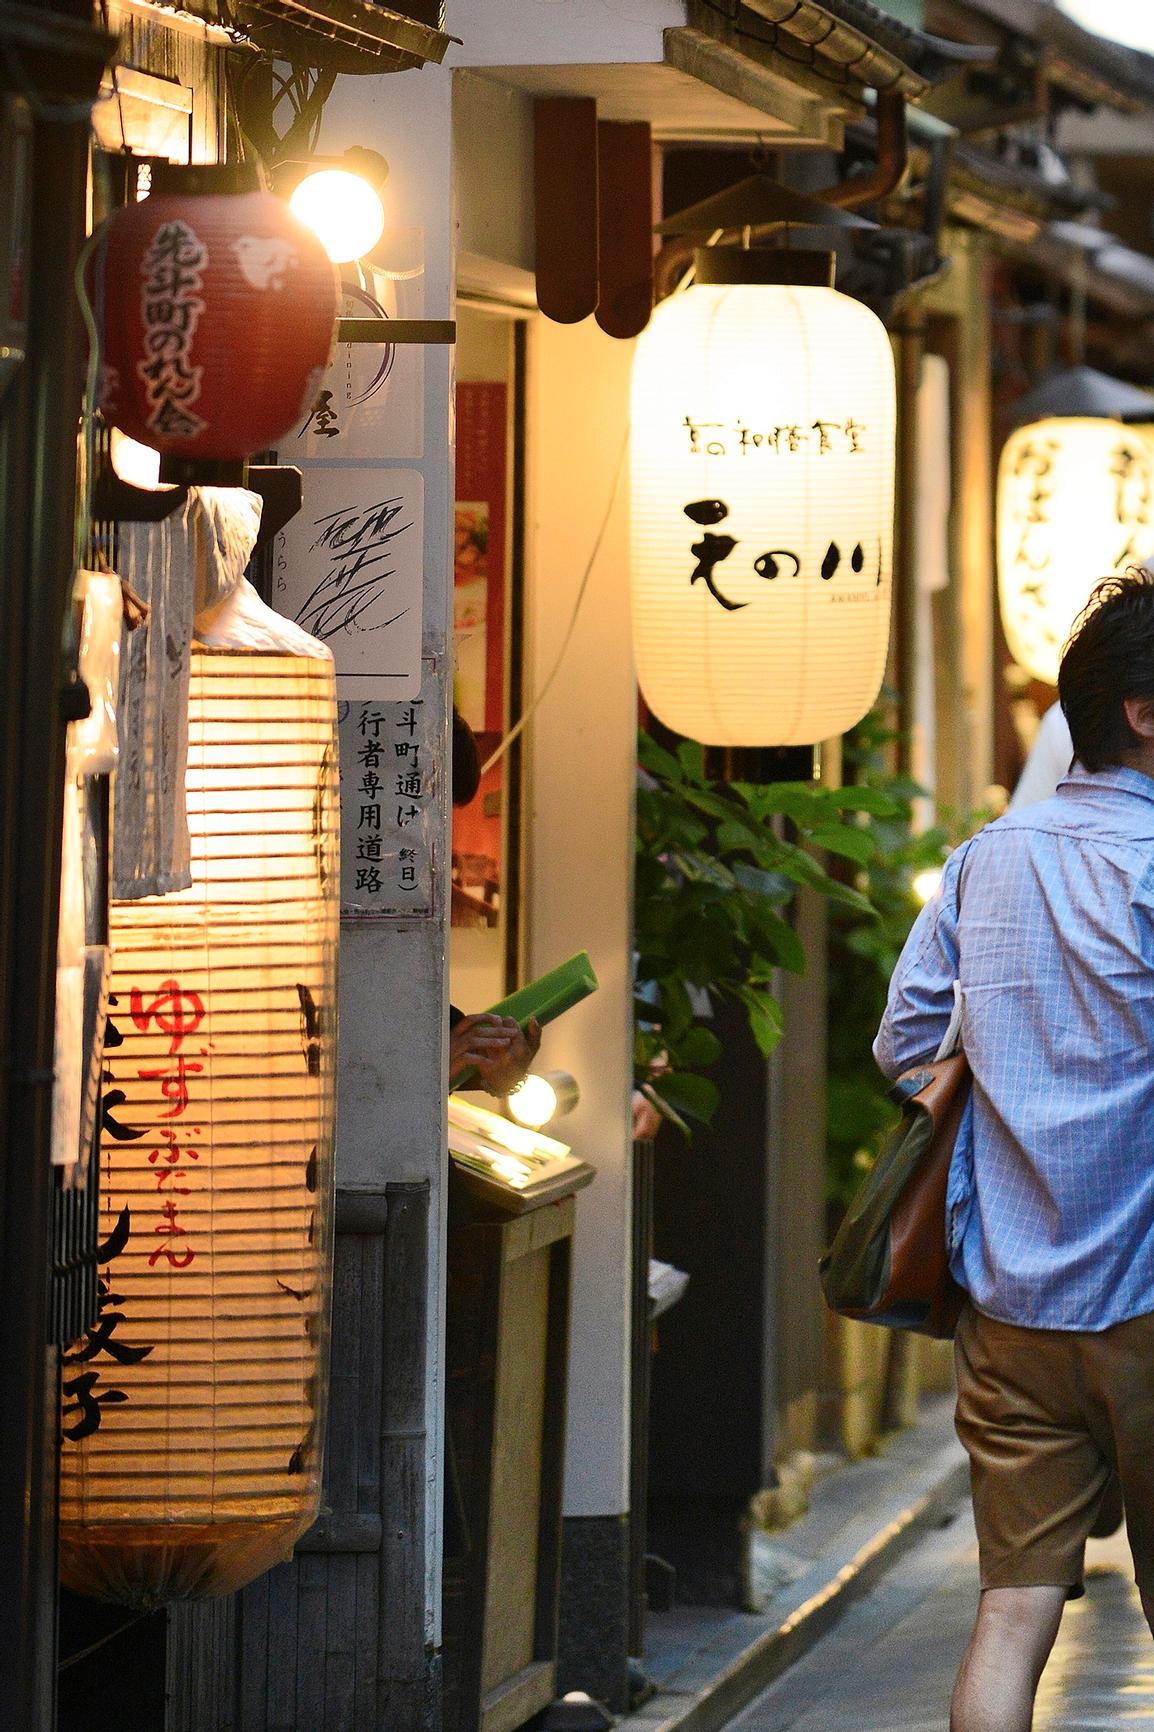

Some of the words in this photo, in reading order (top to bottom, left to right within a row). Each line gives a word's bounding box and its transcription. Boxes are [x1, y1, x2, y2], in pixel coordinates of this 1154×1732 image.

[277, 532, 288, 592] うらら
[355, 701, 387, 894] 行者専用道路
[129, 978, 216, 1268] ゆずぶたまん
